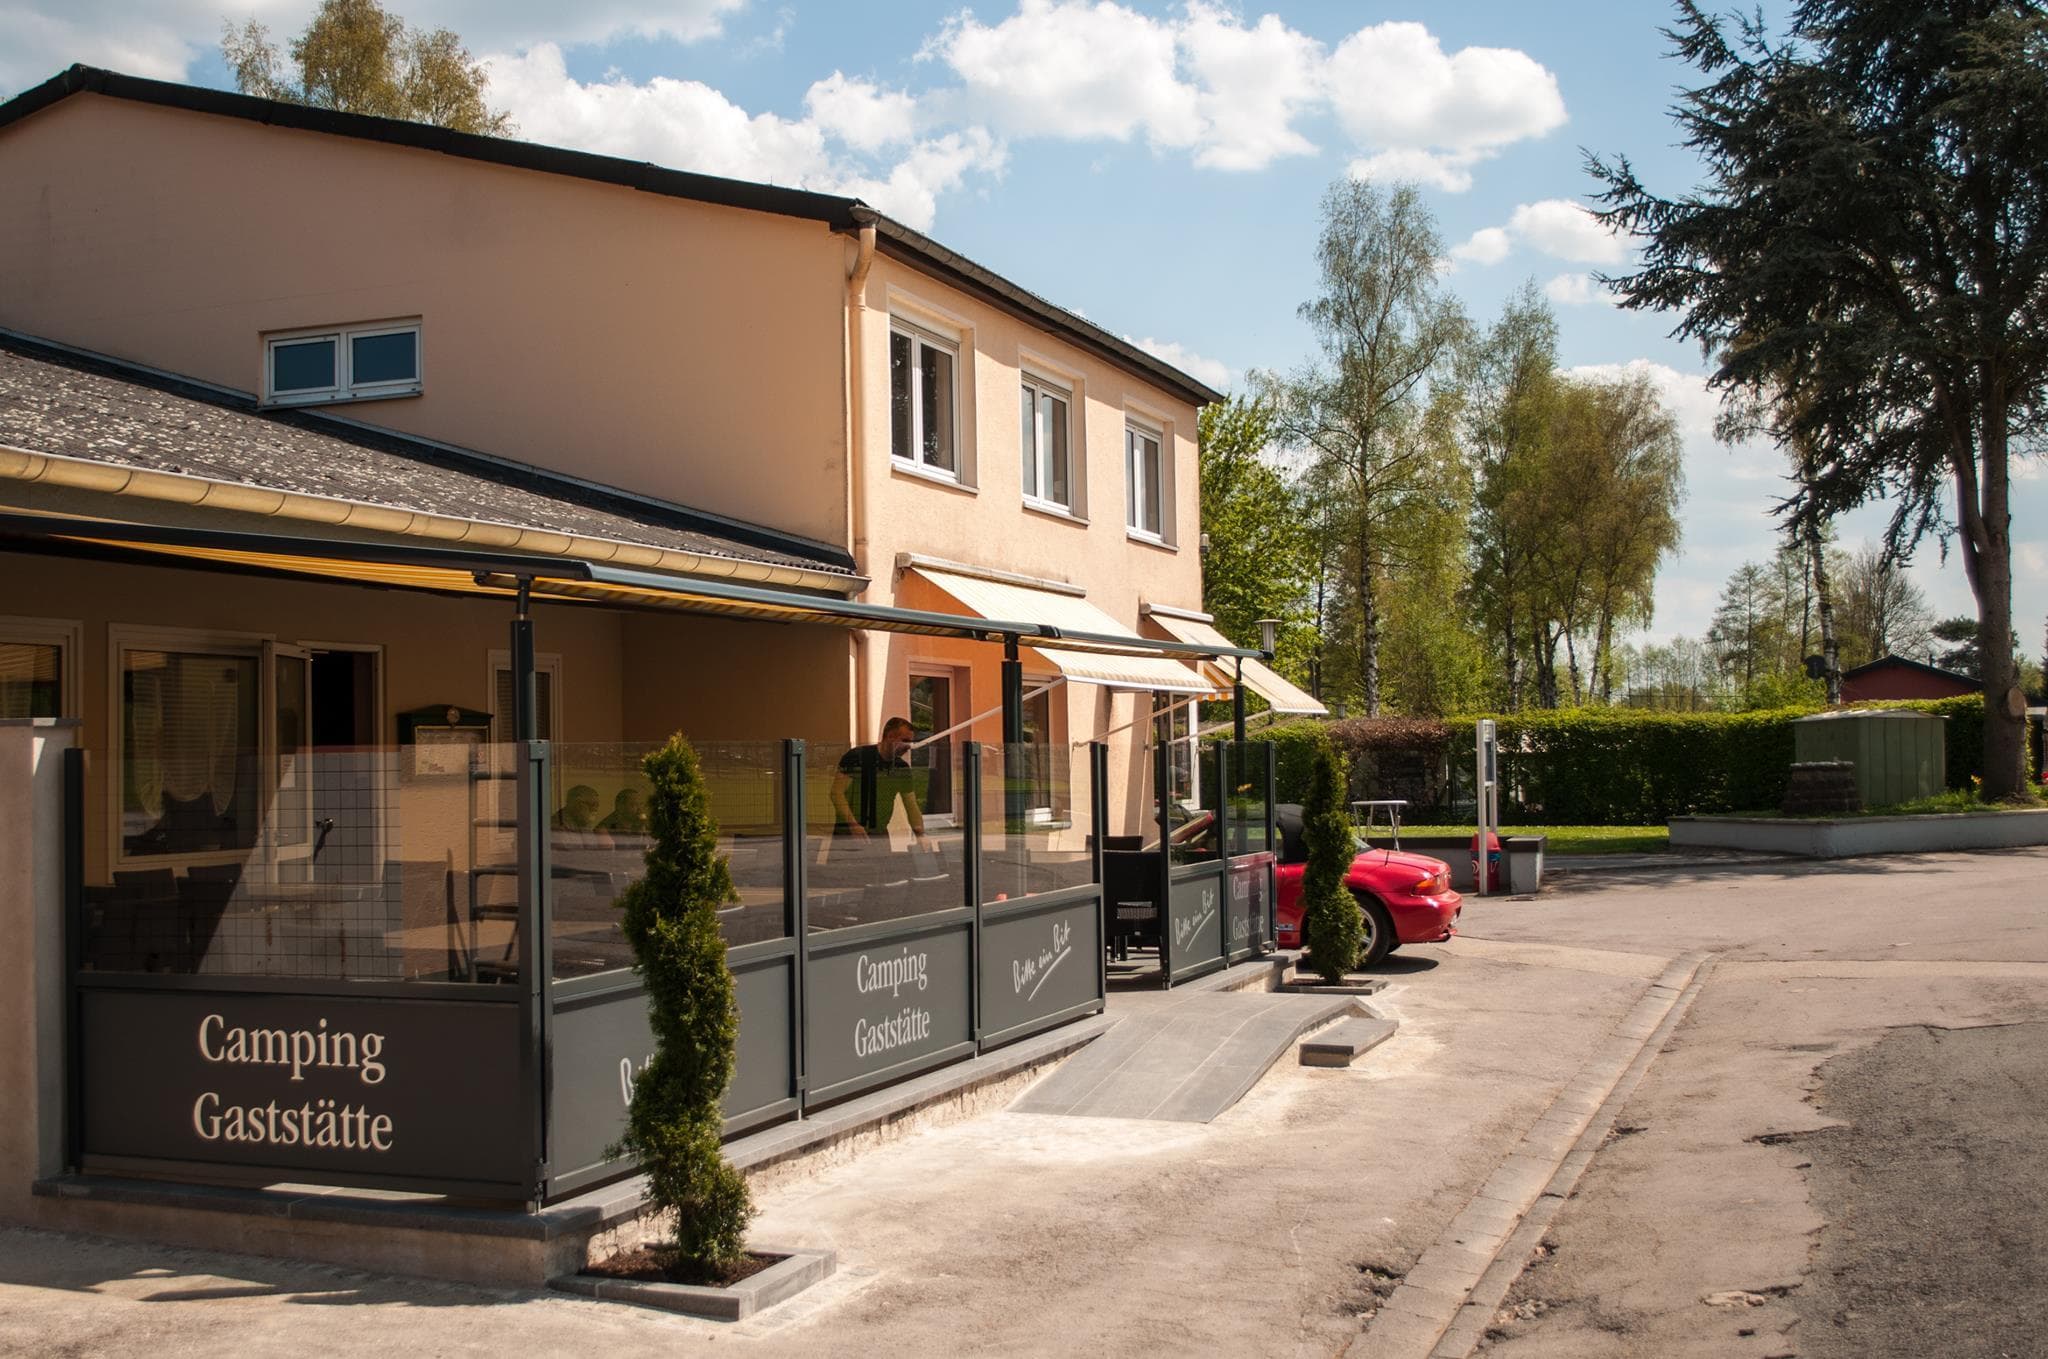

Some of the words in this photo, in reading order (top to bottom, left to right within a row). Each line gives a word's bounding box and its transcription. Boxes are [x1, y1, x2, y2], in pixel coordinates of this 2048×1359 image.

[856, 946, 928, 998] Camping
[1012, 958, 1036, 994] Bitte
[1038, 947, 1053, 969] ein
[1053, 919, 1071, 953] Bit
[199, 1014, 387, 1084] Camping
[854, 1005, 931, 1057] Gaststätte
[192, 1091, 394, 1151] Gaststätte
